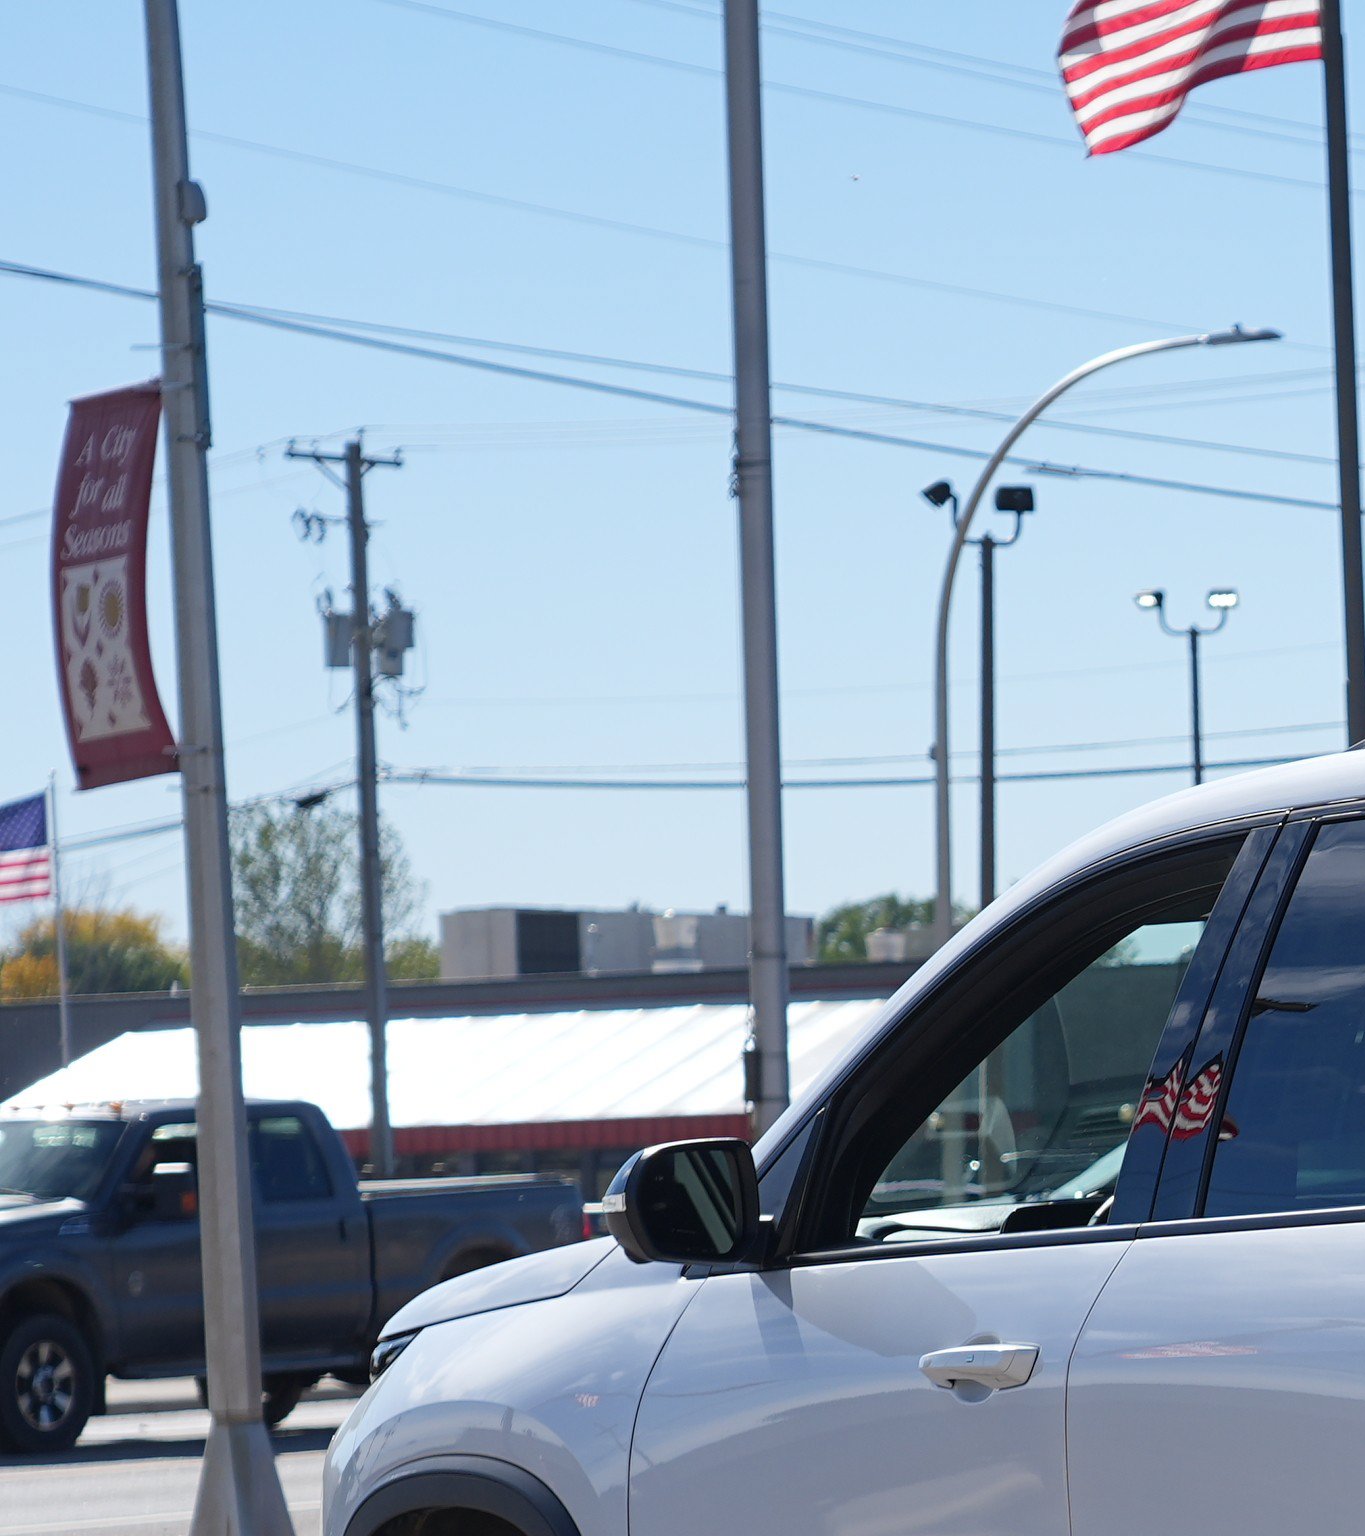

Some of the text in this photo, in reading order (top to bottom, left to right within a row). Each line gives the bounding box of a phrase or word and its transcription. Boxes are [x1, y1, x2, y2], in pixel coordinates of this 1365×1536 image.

[74, 424, 137, 467] A City
[68, 472, 128, 519] for all
[60, 519, 132, 561] Seasons
